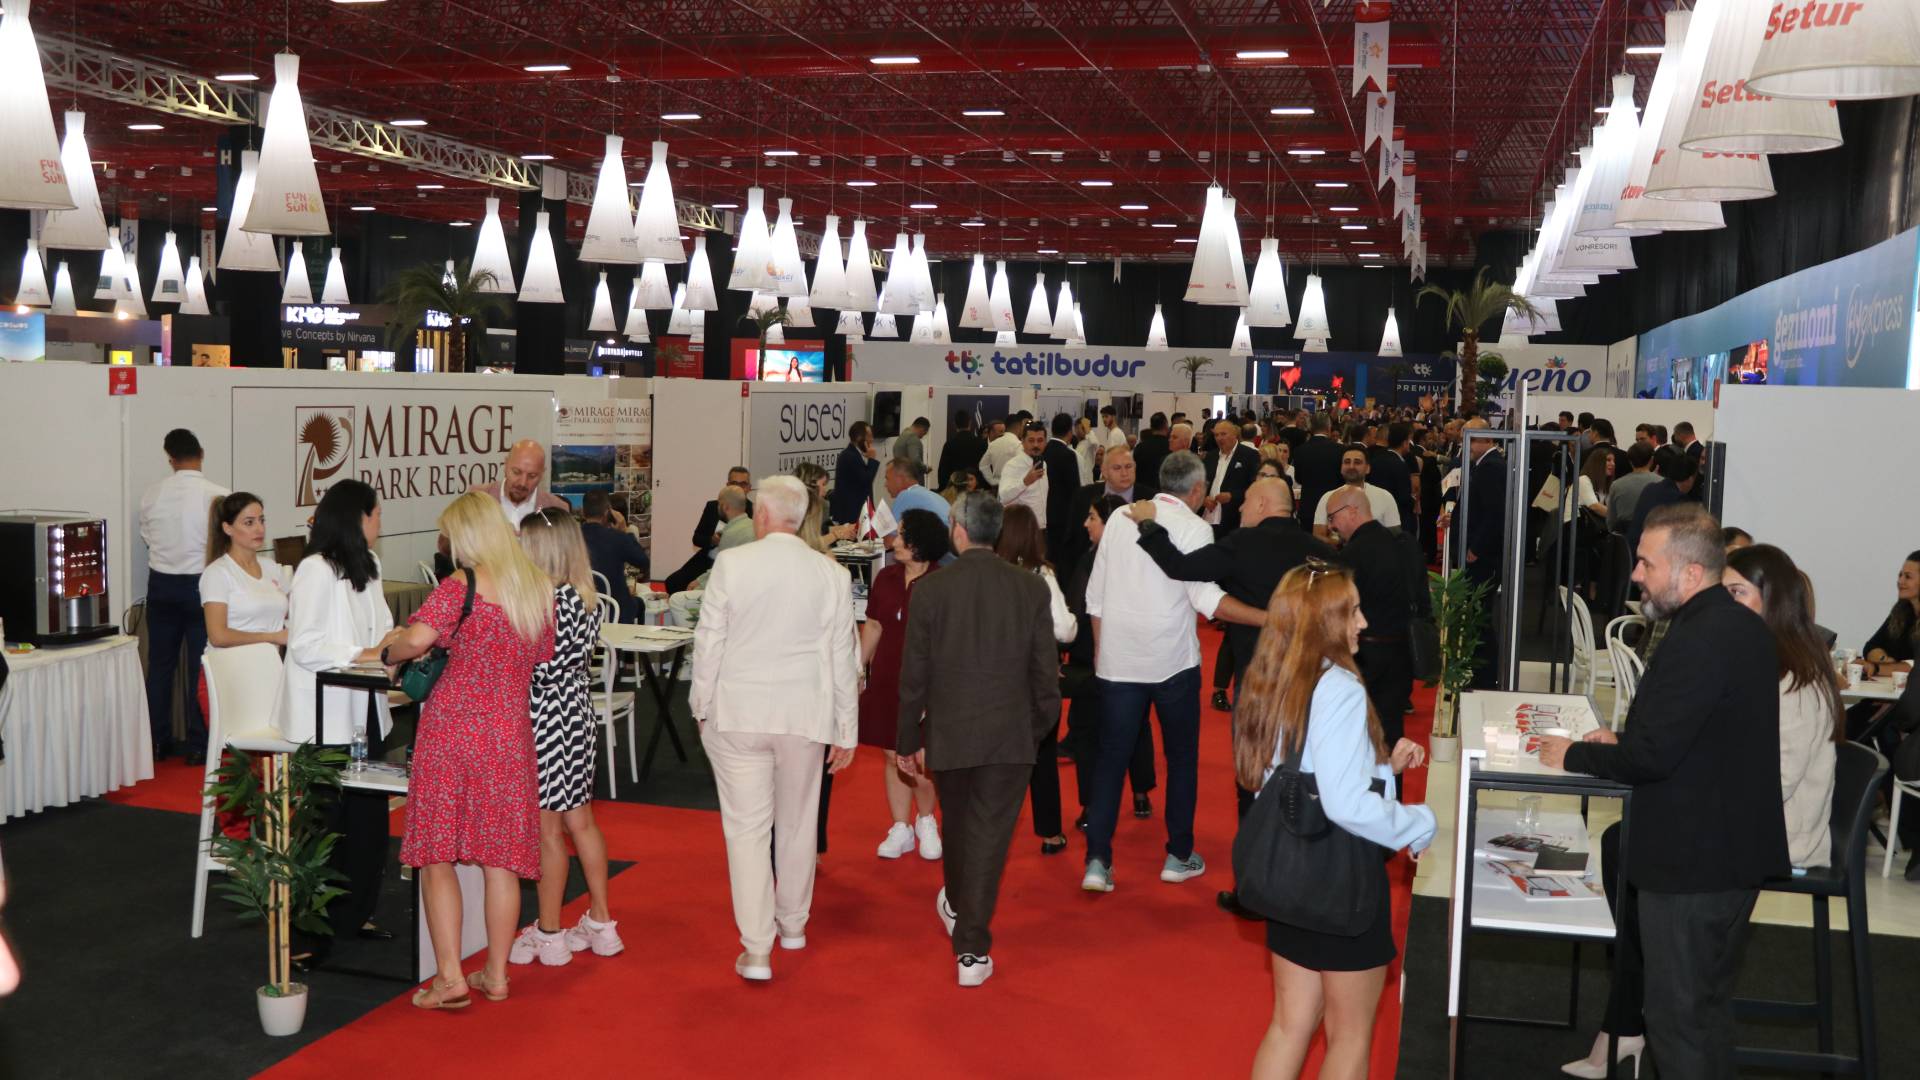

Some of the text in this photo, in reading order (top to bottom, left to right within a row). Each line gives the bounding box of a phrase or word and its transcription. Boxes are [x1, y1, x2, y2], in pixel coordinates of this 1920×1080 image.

[1764, 0, 1864, 40] Setur
[282, 328, 376, 343] ve Concepts by Nirvana
[990, 351, 1146, 378] tatilbudur
[574, 407, 615, 417] MIRAGE
[617, 407, 650, 417] MIRAG
[780, 398, 847, 443] susesi
[359, 404, 514, 459] MIRAGE
[359, 466, 422, 500] PARK
